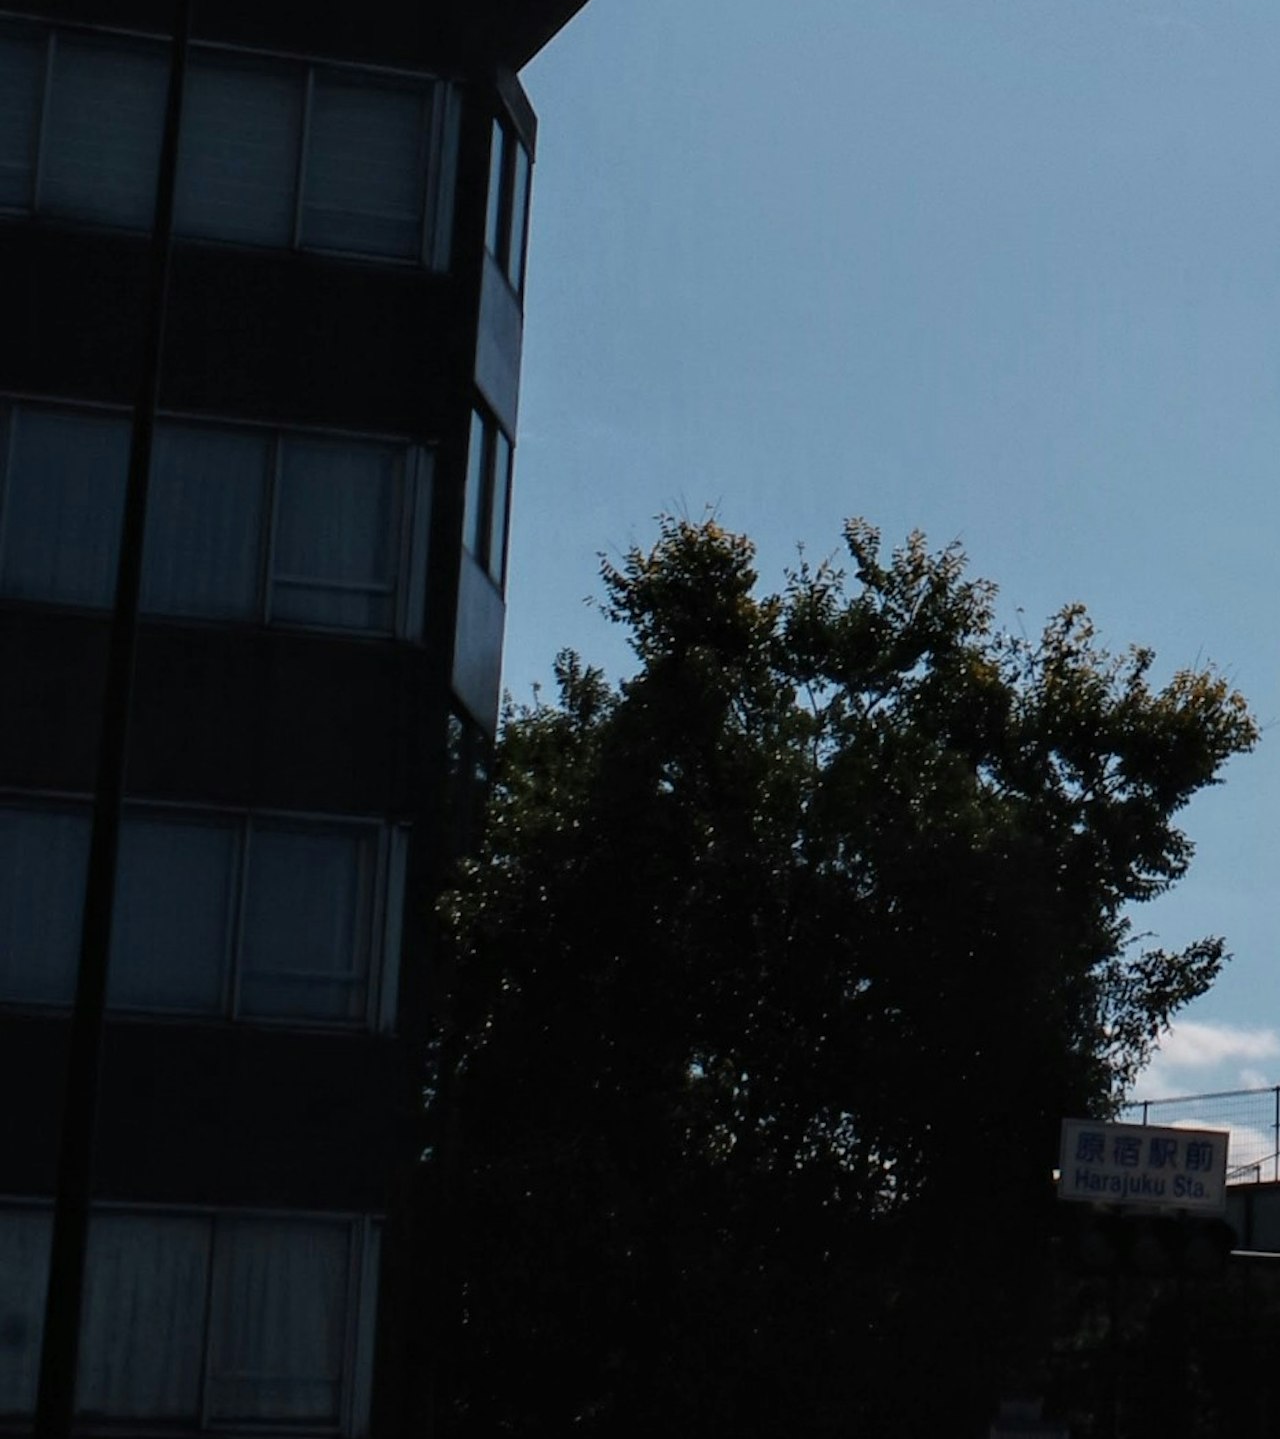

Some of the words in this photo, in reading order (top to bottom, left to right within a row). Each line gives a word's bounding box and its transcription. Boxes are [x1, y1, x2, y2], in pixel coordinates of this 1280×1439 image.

[1075, 1131, 1214, 1172] 原宿駅前
[1075, 1169, 1166, 1198] Harajuku
[1173, 1175, 1210, 1199] Sta.
